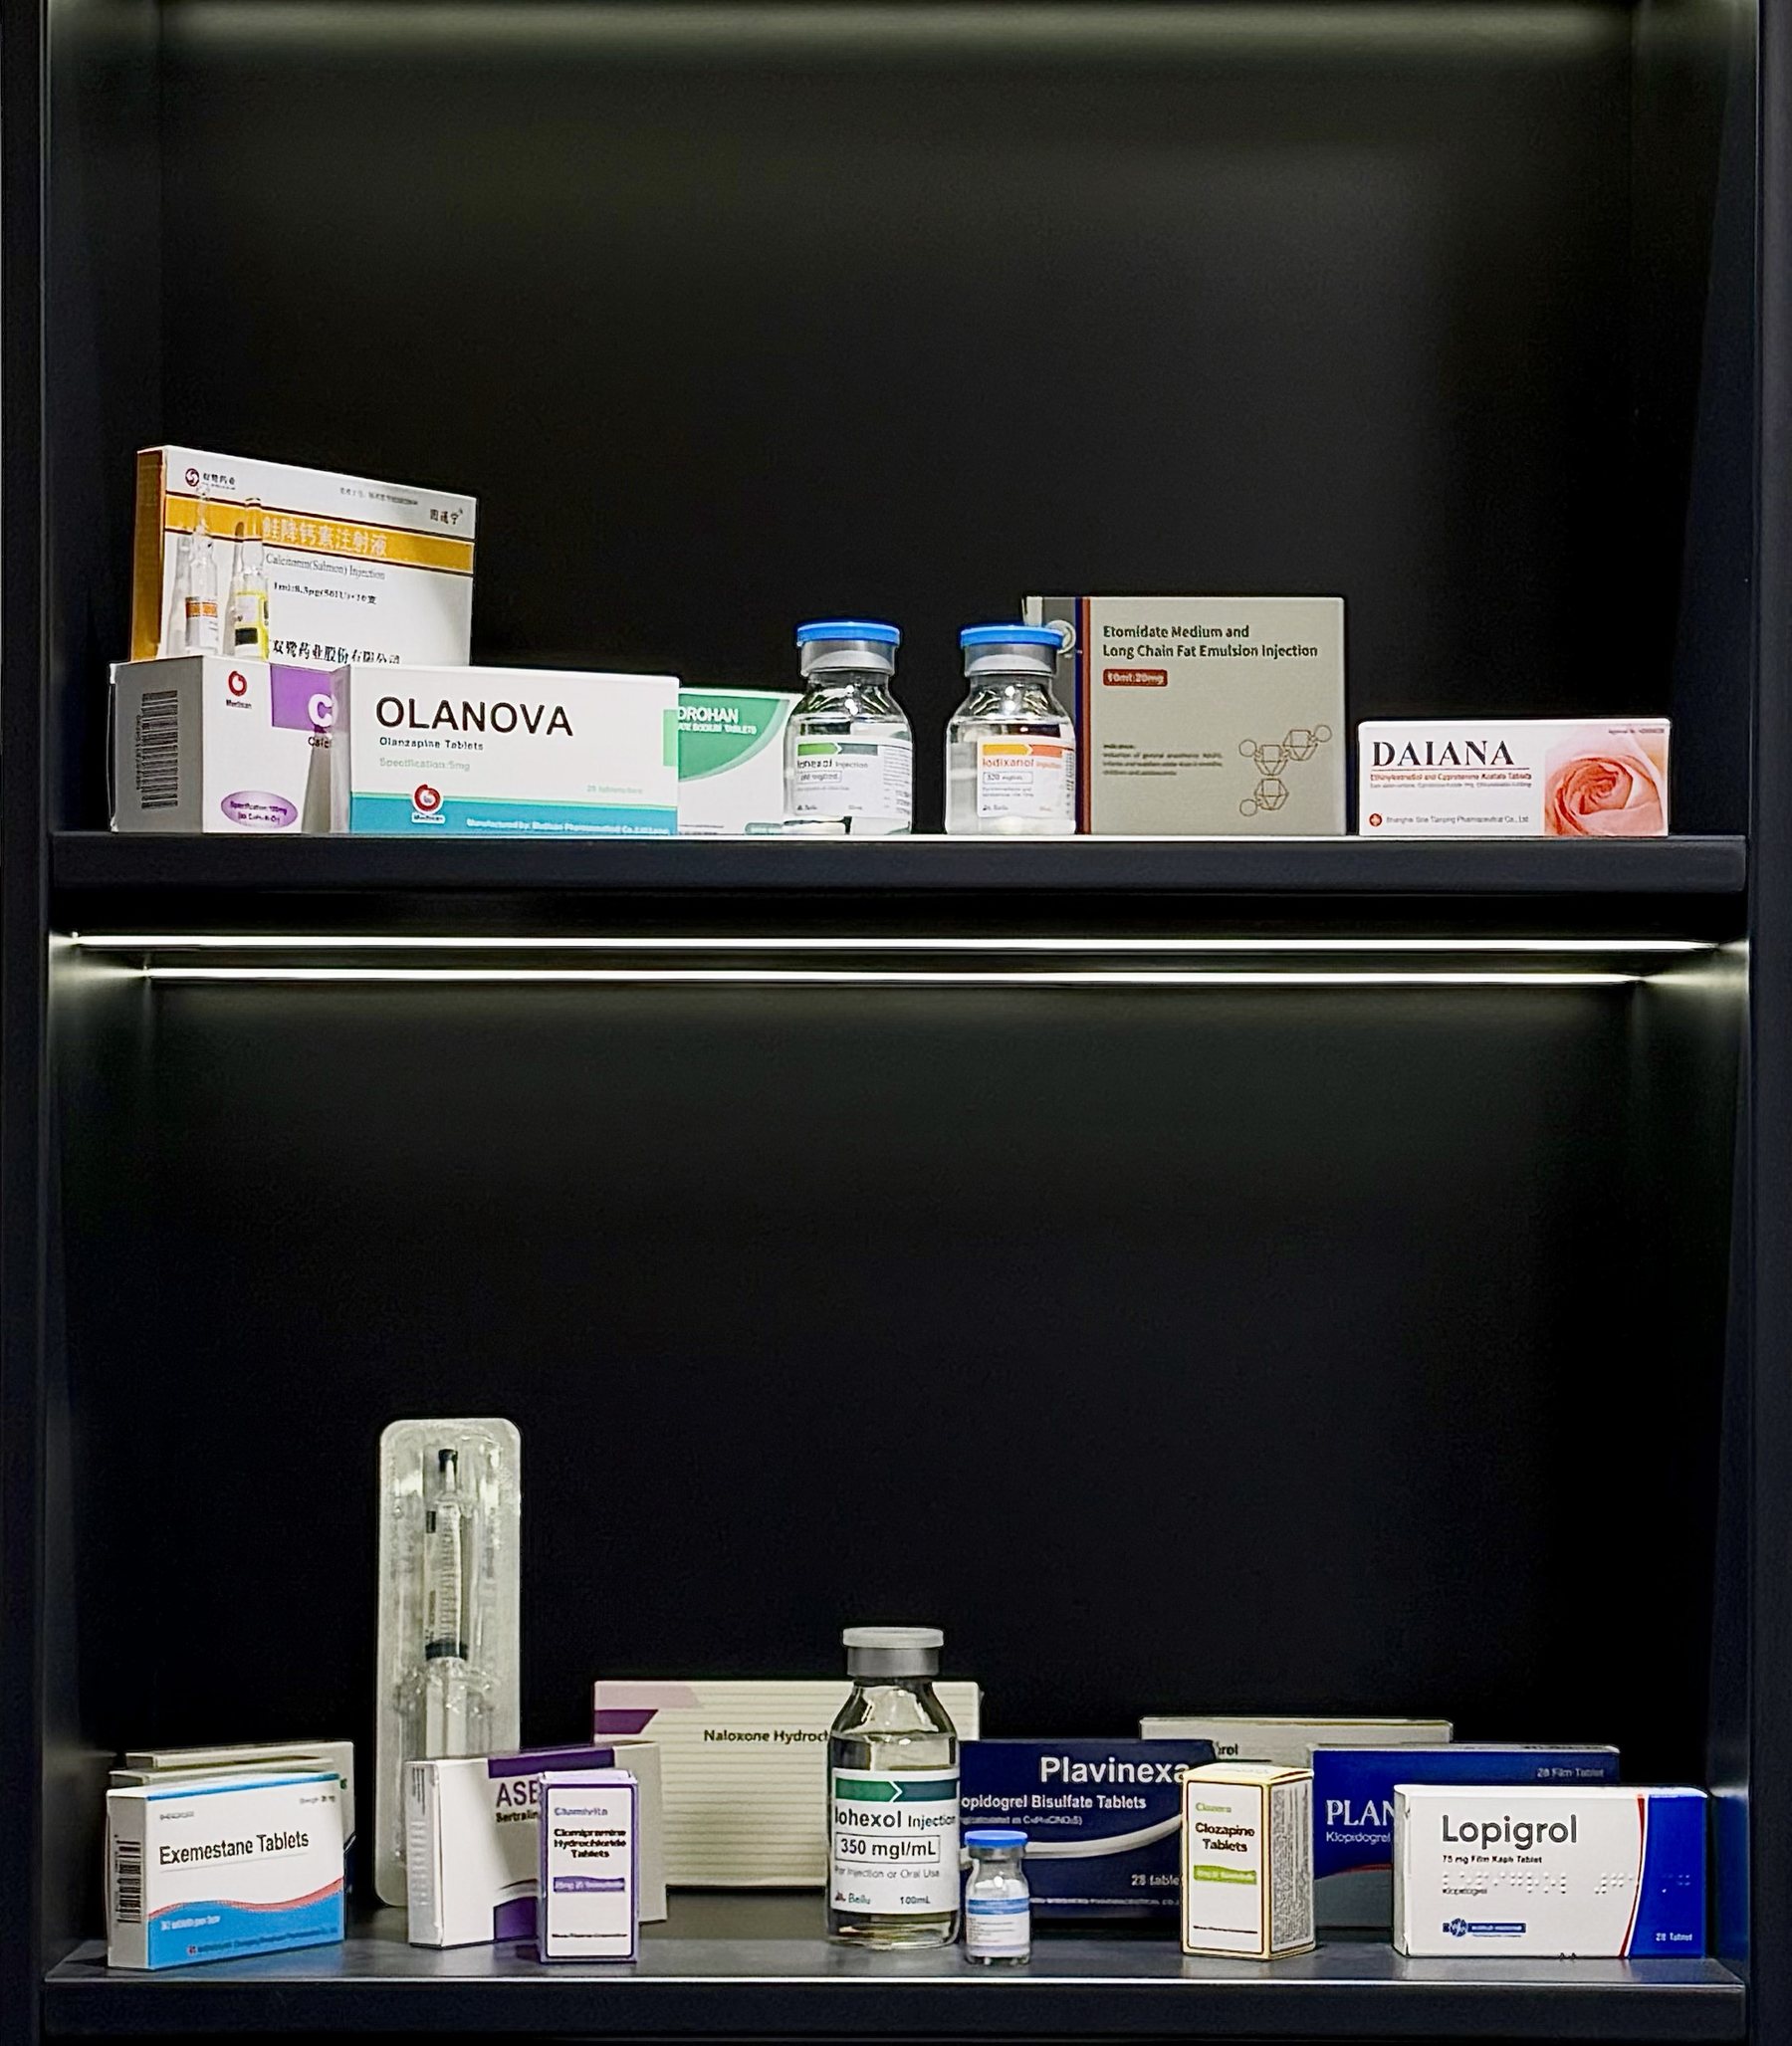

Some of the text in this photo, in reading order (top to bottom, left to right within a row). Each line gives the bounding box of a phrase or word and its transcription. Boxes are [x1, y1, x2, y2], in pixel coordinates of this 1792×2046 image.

[1103, 625, 1250, 639] Etomidate Medium and
[1103, 644, 1318, 660] Long Chain Fat Emulsion Injection
[375, 696, 574, 737] OLANOVA
[379, 736, 484, 751] Olanzapine Tablets
[1372, 740, 1515, 767] DAIANA
[704, 1729, 771, 1741] Naloxone
[961, 1794, 1147, 1811] opidogrel Bisulfate Tablets
[834, 1805, 902, 1828] Iohexol
[1195, 1822, 1255, 1838] Clozapine
[1443, 1814, 1577, 1850] Lopigrol
[159, 1831, 310, 1865] Exemestane Tablets
[840, 1838, 866, 1855] 350
[1203, 1838, 1247, 1852] Tablets
[570, 1850, 610, 1860] Tablets
